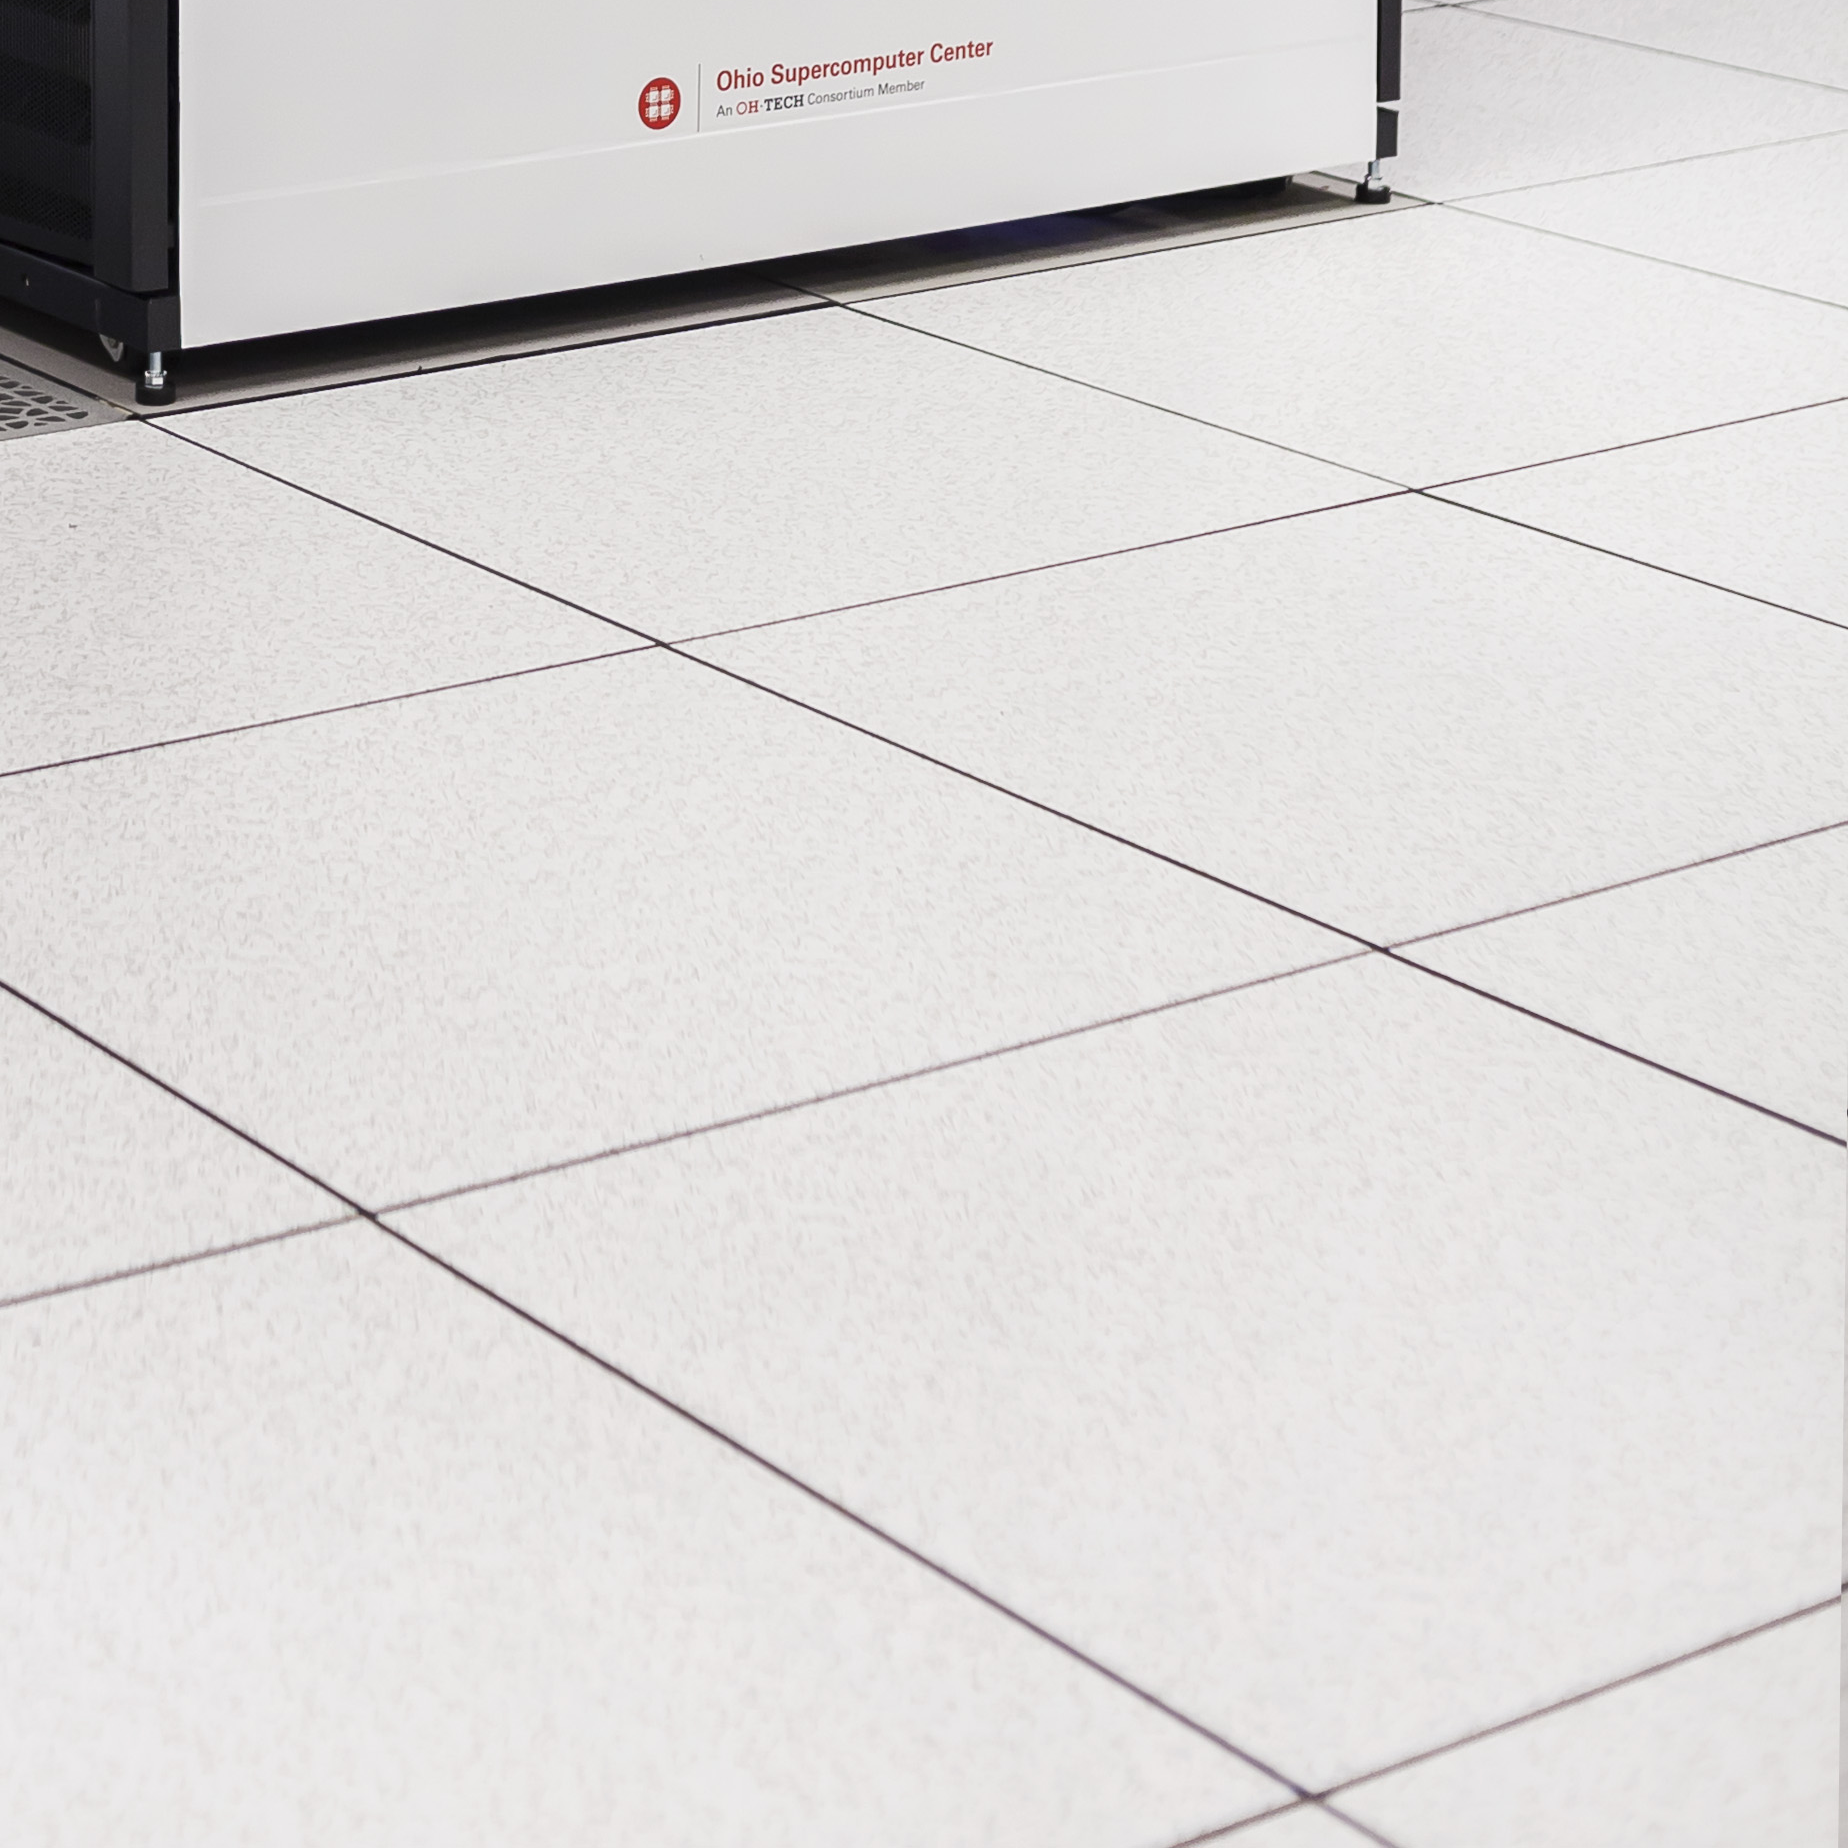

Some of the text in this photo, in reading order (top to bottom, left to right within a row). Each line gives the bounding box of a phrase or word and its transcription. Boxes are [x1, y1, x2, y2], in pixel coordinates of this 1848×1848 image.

[716, 39, 994, 92] Ohio Supercomputer Center
[716, 104, 733, 118] An
[807, 86, 875, 106] Consortium
[878, 79, 926, 96] Member
